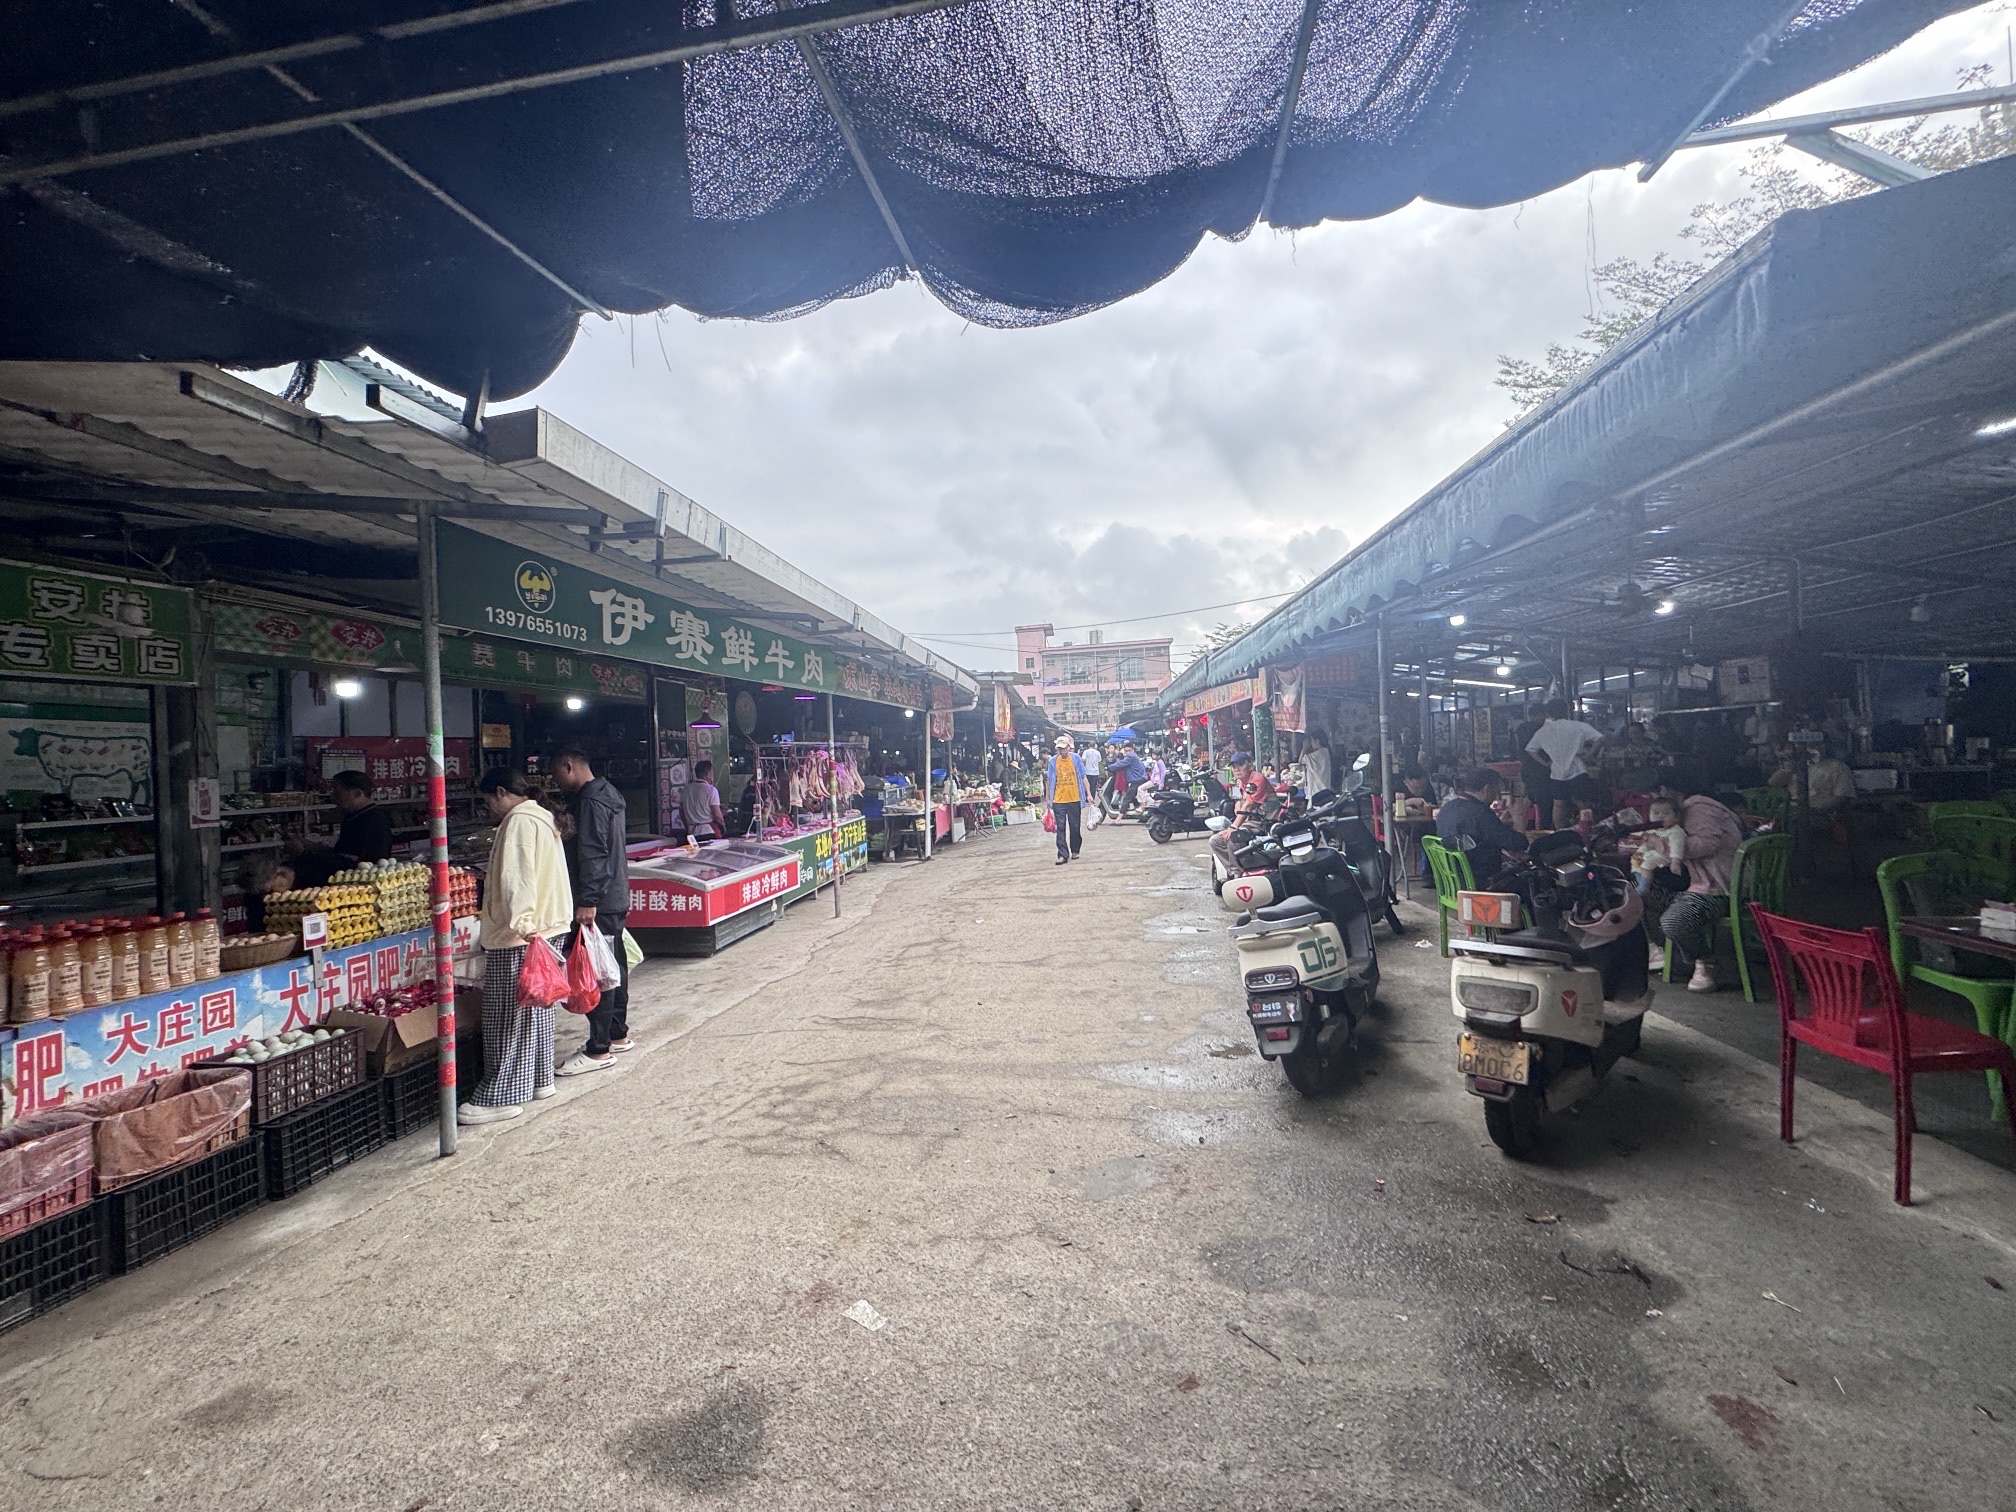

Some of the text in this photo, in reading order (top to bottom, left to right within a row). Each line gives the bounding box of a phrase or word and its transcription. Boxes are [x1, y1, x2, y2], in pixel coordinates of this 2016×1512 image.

[485, 606, 588, 642] 13976551073
[589, 588, 824, 686] 伊赛鲜牛肉
[0, 620, 181, 674] 专卖店
[438, 636, 572, 677] 赛牛肉
[373, 755, 460, 780] 排酸冷肉
[816, 819, 866, 860] 本地小牛万宁东山羊
[628, 889, 703, 912] 排酸猪肉
[741, 869, 788, 904] 排酸冷鲜肉
[279, 926, 472, 1033] 大庄园肥牛羊
[106, 988, 236, 1065] 大庄园
[14, 1031, 66, 1119] 肥
